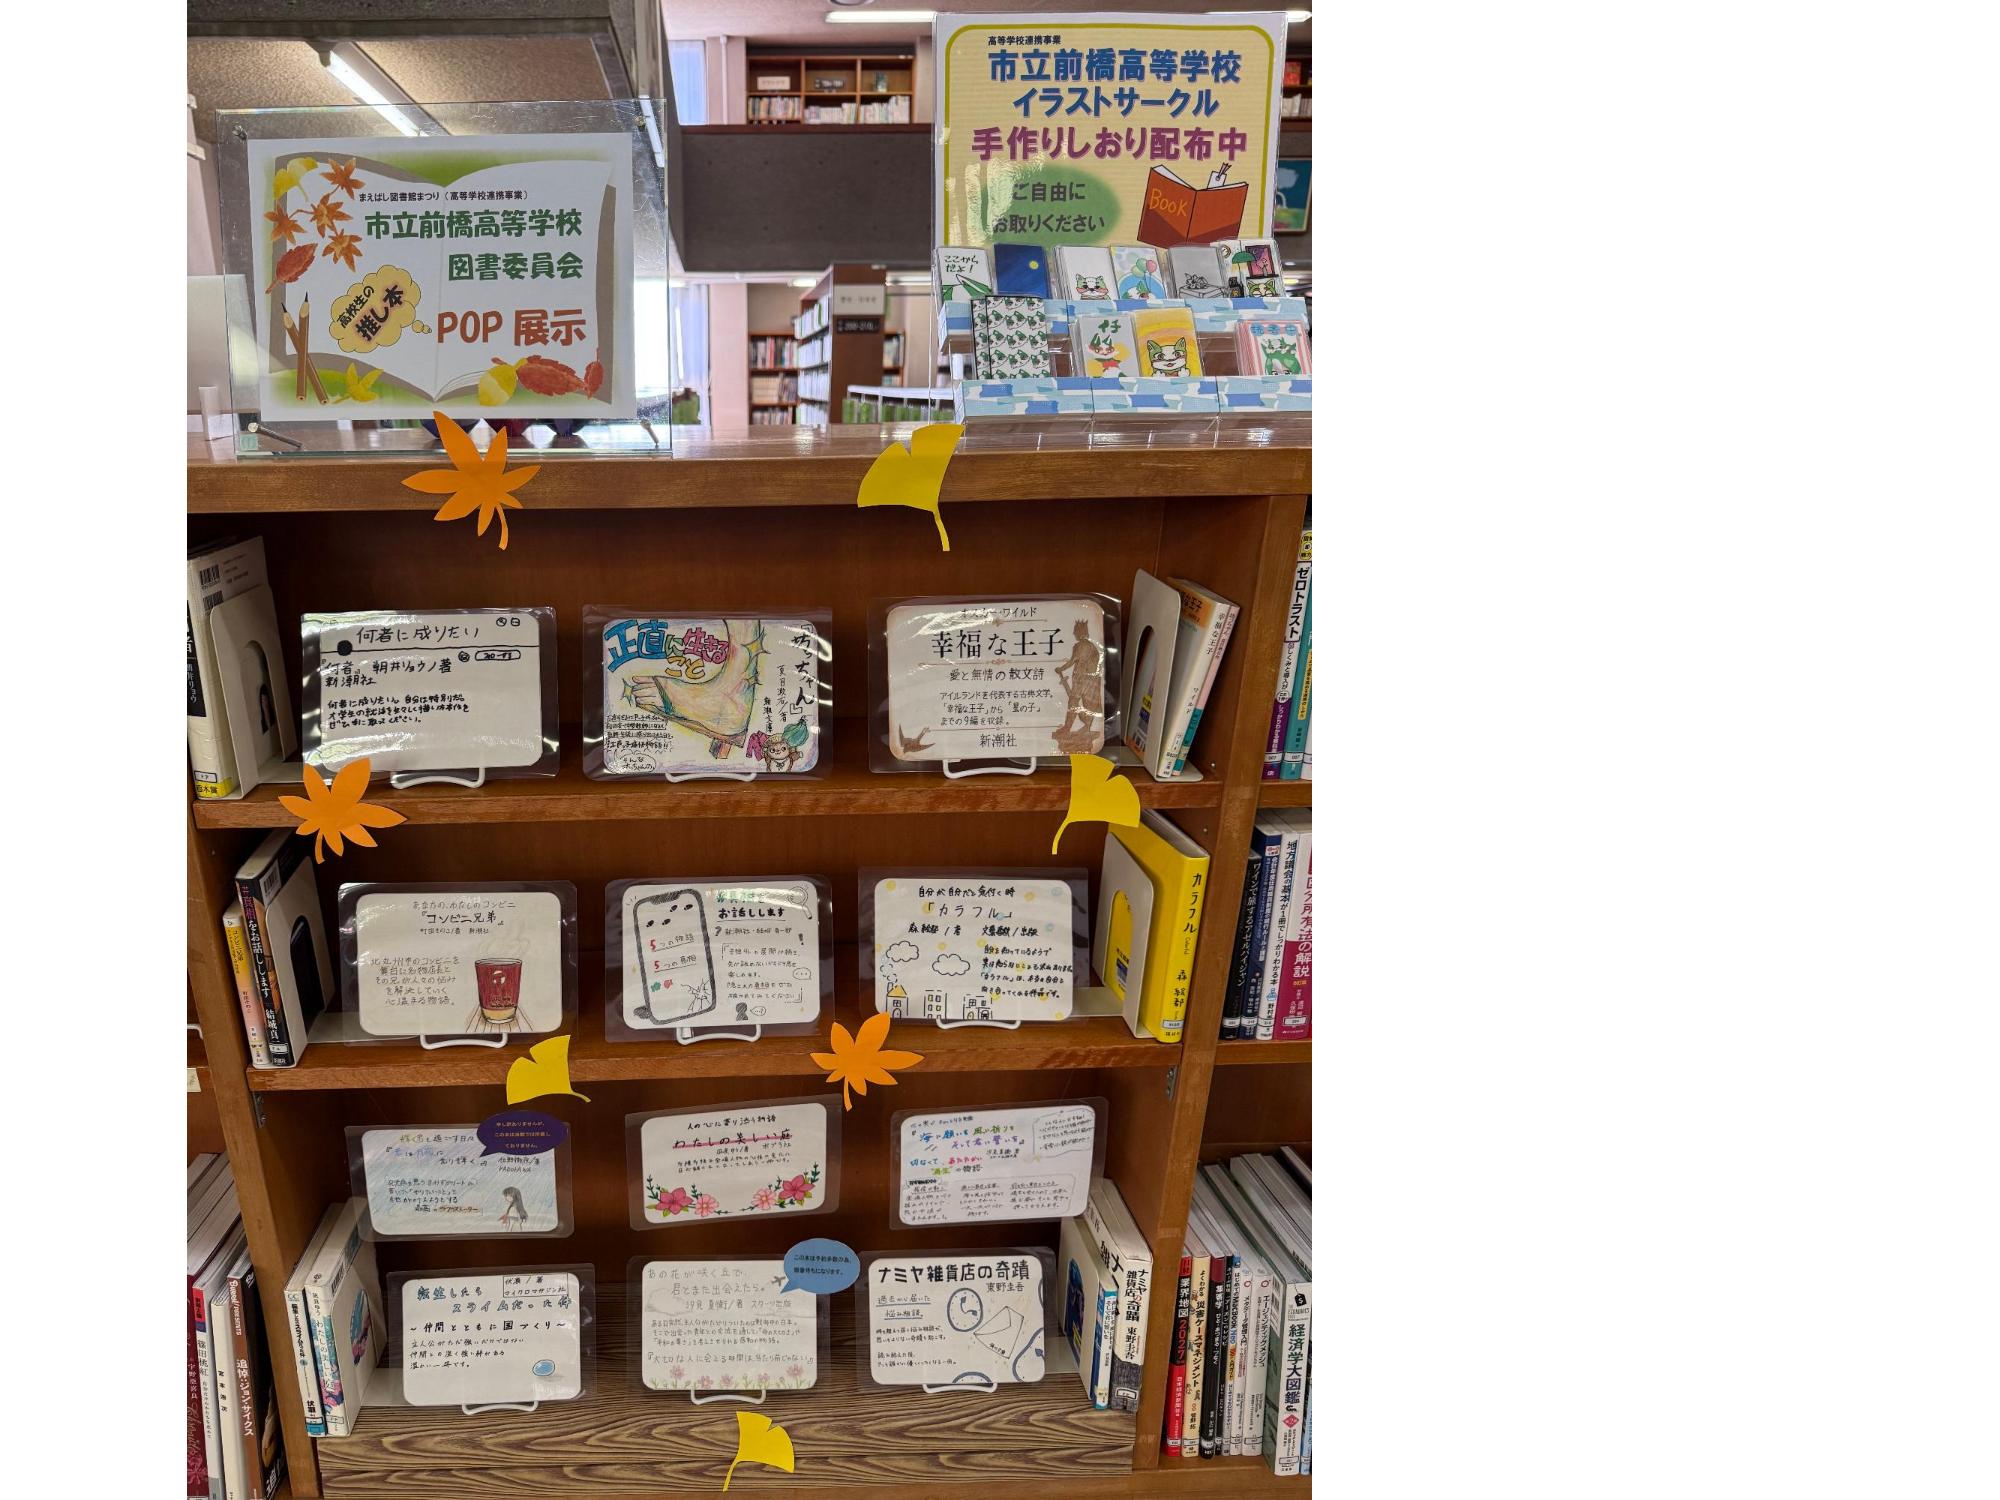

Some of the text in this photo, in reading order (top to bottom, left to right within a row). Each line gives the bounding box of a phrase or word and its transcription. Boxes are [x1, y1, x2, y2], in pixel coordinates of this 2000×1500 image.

[988, 35, 1061, 46] 高等学校連携事業
[988, 48, 1242, 83] 市立前橋高等学校
[1013, 87, 1219, 118] イラストサークル
[971, 126, 1247, 161] 手作りしおり配布中
[1011, 182, 1086, 202] ご自由に
[365, 209, 582, 239] 市立前橋高等学校
[993, 214, 1104, 234] お取りください
[448, 252, 583, 281] 図書委員会
[944, 255, 978, 263] ここから
[337, 285, 374, 329] 高校生の
[355, 285, 404, 342] 推し本
[437, 309, 586, 346] POP 展示
[1289, 566, 1311, 639] ゼロトラスト
[357, 627, 479, 644] 何者に成りたい
[604, 619, 730, 673] 正直に生きる
[931, 628, 1064, 658] 幸福な王子
[665, 656, 705, 679] こと
[950, 668, 1044, 681] 愛と無情の散文詩
[325, 674, 376, 687] 新潮社
[939, 689, 1053, 700] アイルランドを代表する古典文学。
[979, 733, 1017, 747] 新潮社
[718, 908, 785, 919] お話しします
[1184, 873, 1201, 934] カラフル
[674, 1129, 793, 1149] わたしの美しい庭
[879, 1260, 1030, 1283] ナミヤ雑貨店の奇蹟
[1137, 1269, 1149, 1295] ナミヤ
[417, 1286, 482, 1300] 転生したら
[504, 1286, 566, 1296] マイクロマガジン社
[671, 1283, 765, 1296] 君とまた出会えたら。
[986, 1282, 1024, 1293] 東野圭吾
[1178, 1278, 1190, 1318] 業界地図
[452, 1296, 571, 1313] スライムだった件
[878, 1294, 930, 1305] 過去から届いた
[1125, 1327, 1138, 1360] 東野圭吾
[1284, 1323, 1306, 1406] 経済学大図鑑
